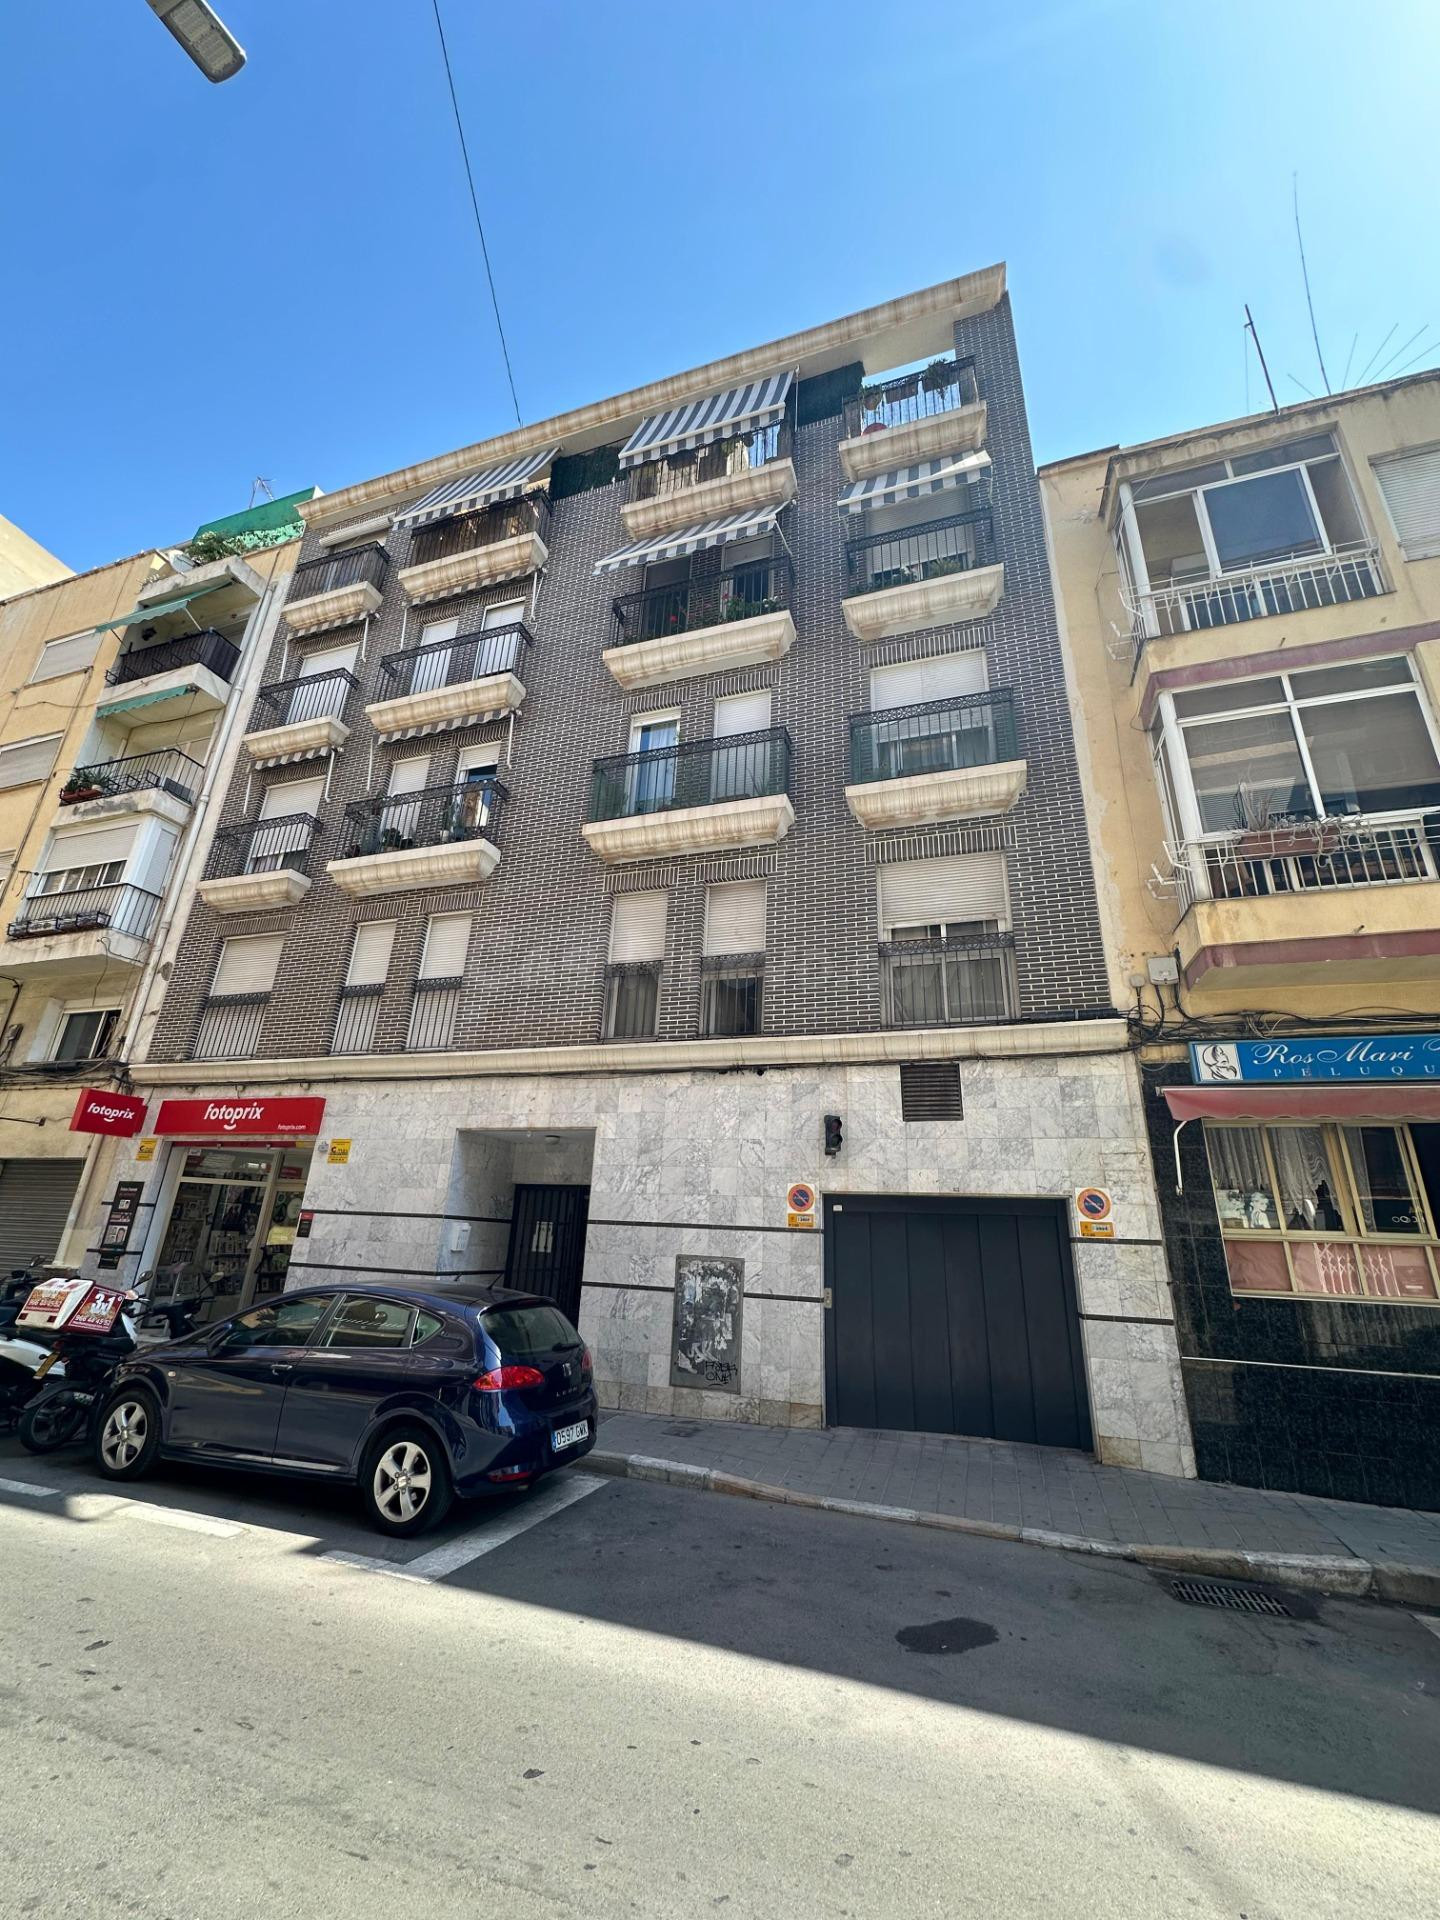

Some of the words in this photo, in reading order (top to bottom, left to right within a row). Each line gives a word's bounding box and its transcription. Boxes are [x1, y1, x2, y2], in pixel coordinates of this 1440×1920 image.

[1250, 1043, 1315, 1065] Ros
[1317, 1041, 1414, 1063] Mari
[87, 1103, 135, 1119] fotoprix
[204, 1102, 264, 1124] fotoprix
[556, 1427, 574, 1446] 0597
